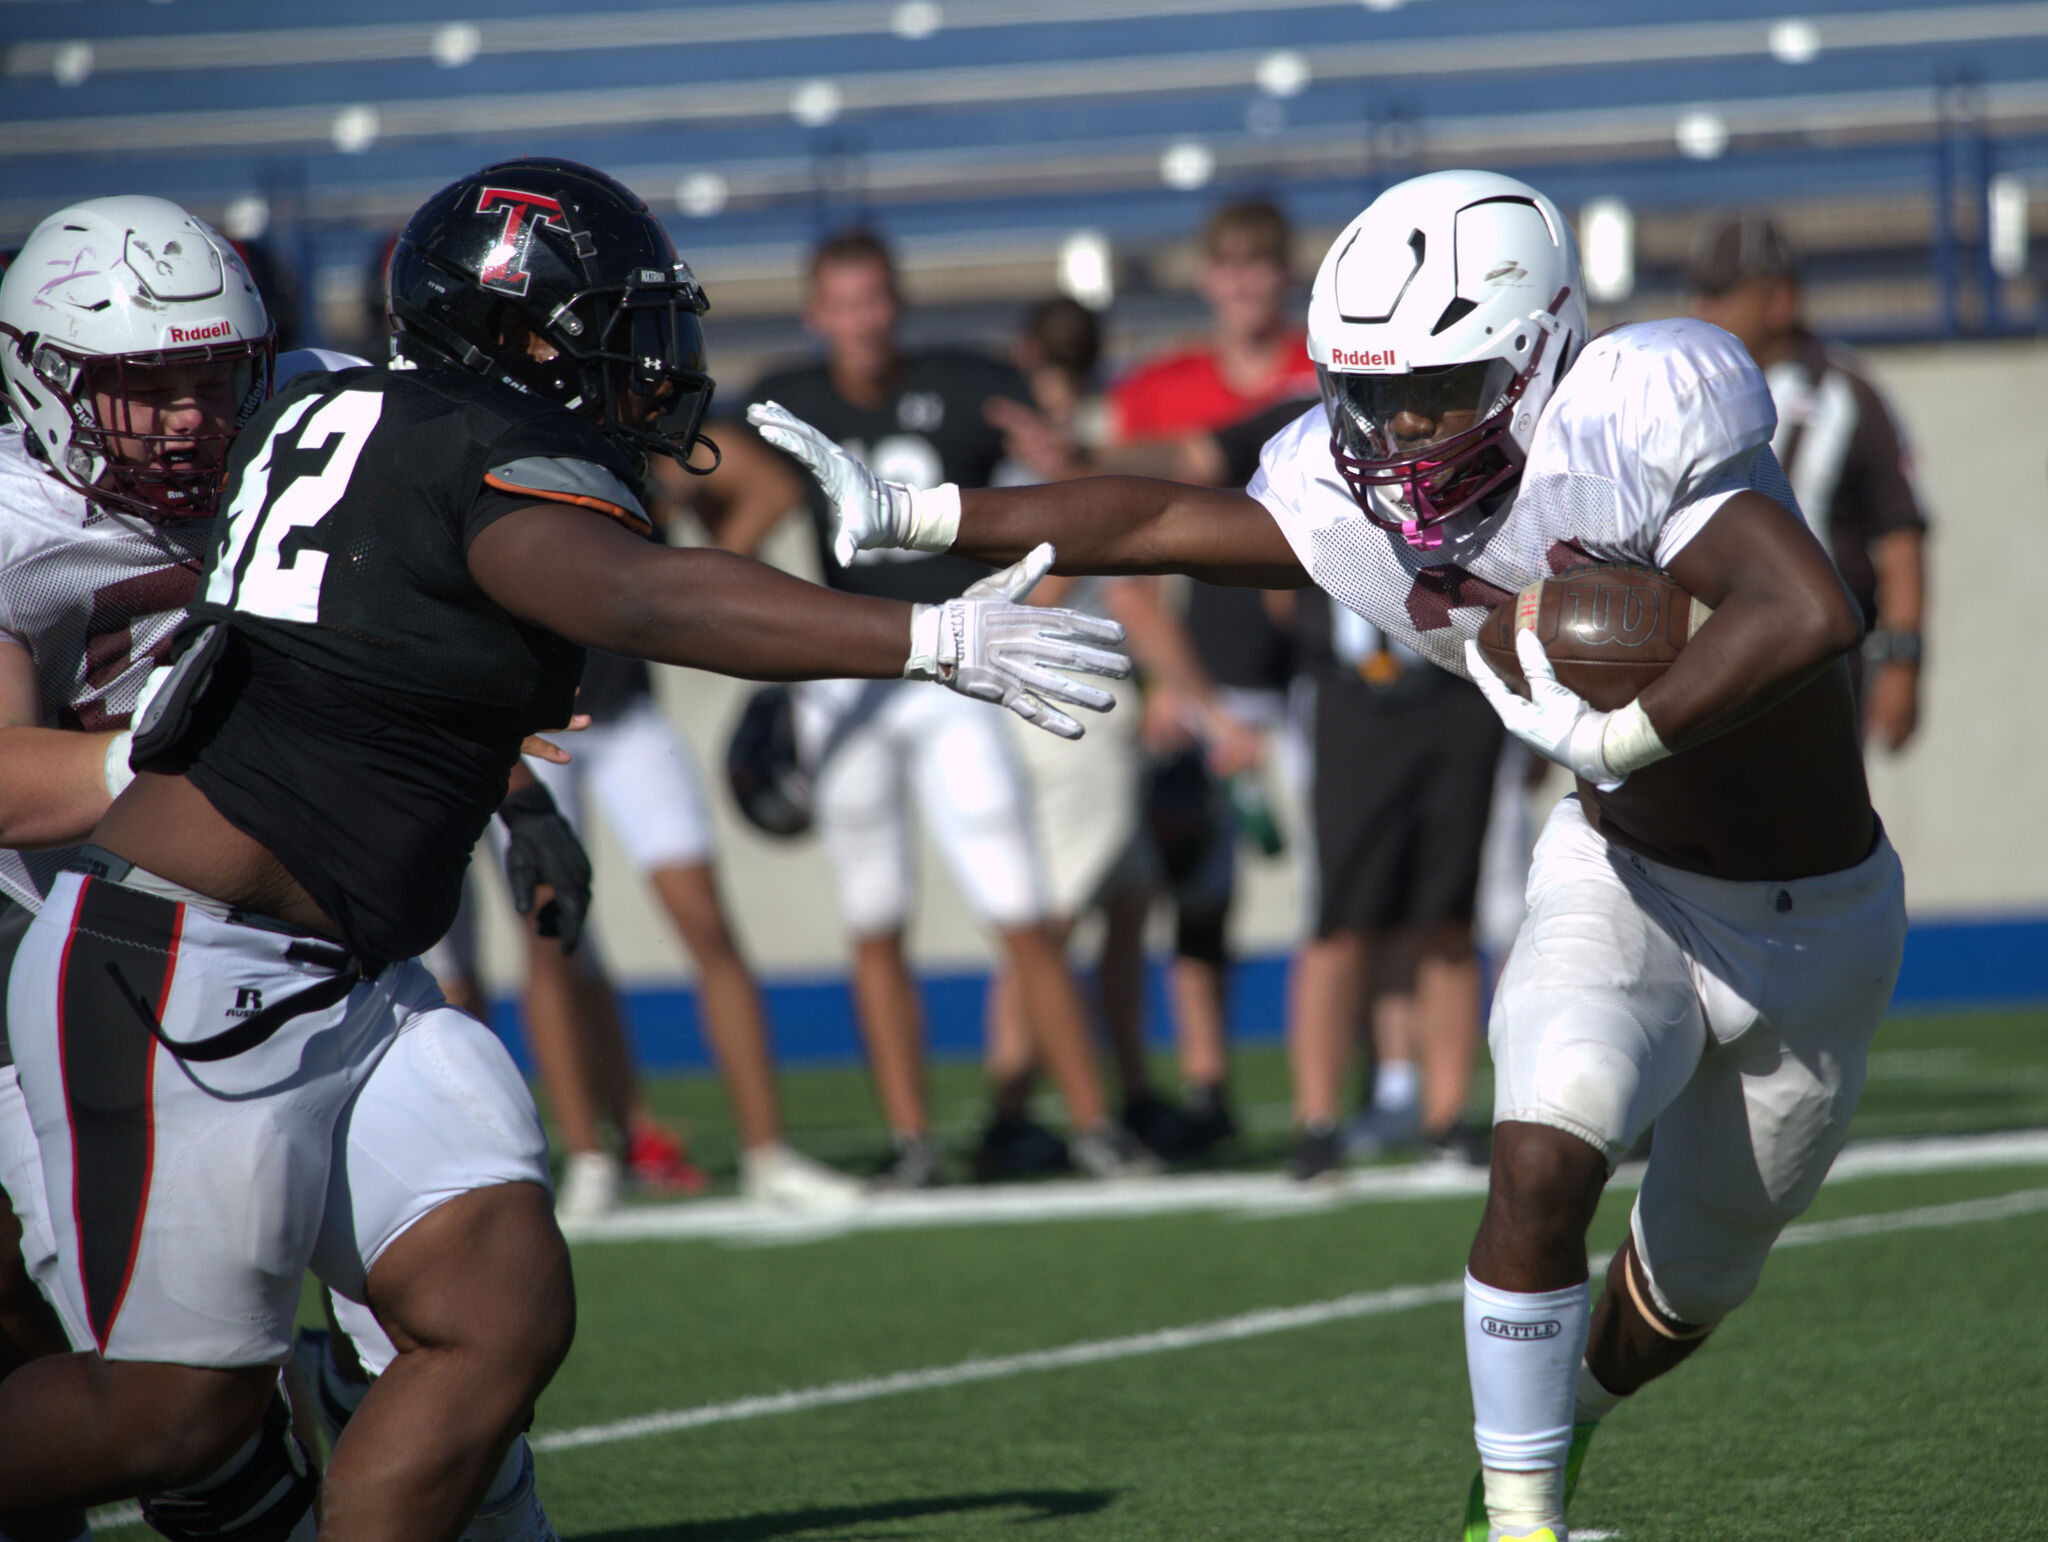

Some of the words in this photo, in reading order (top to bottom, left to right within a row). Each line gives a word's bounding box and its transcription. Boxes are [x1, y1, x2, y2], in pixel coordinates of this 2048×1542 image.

[171, 321, 231, 343] Riddell
[1332, 349, 1396, 366] Riddell
[1487, 1320, 1554, 1337] BATTLE
